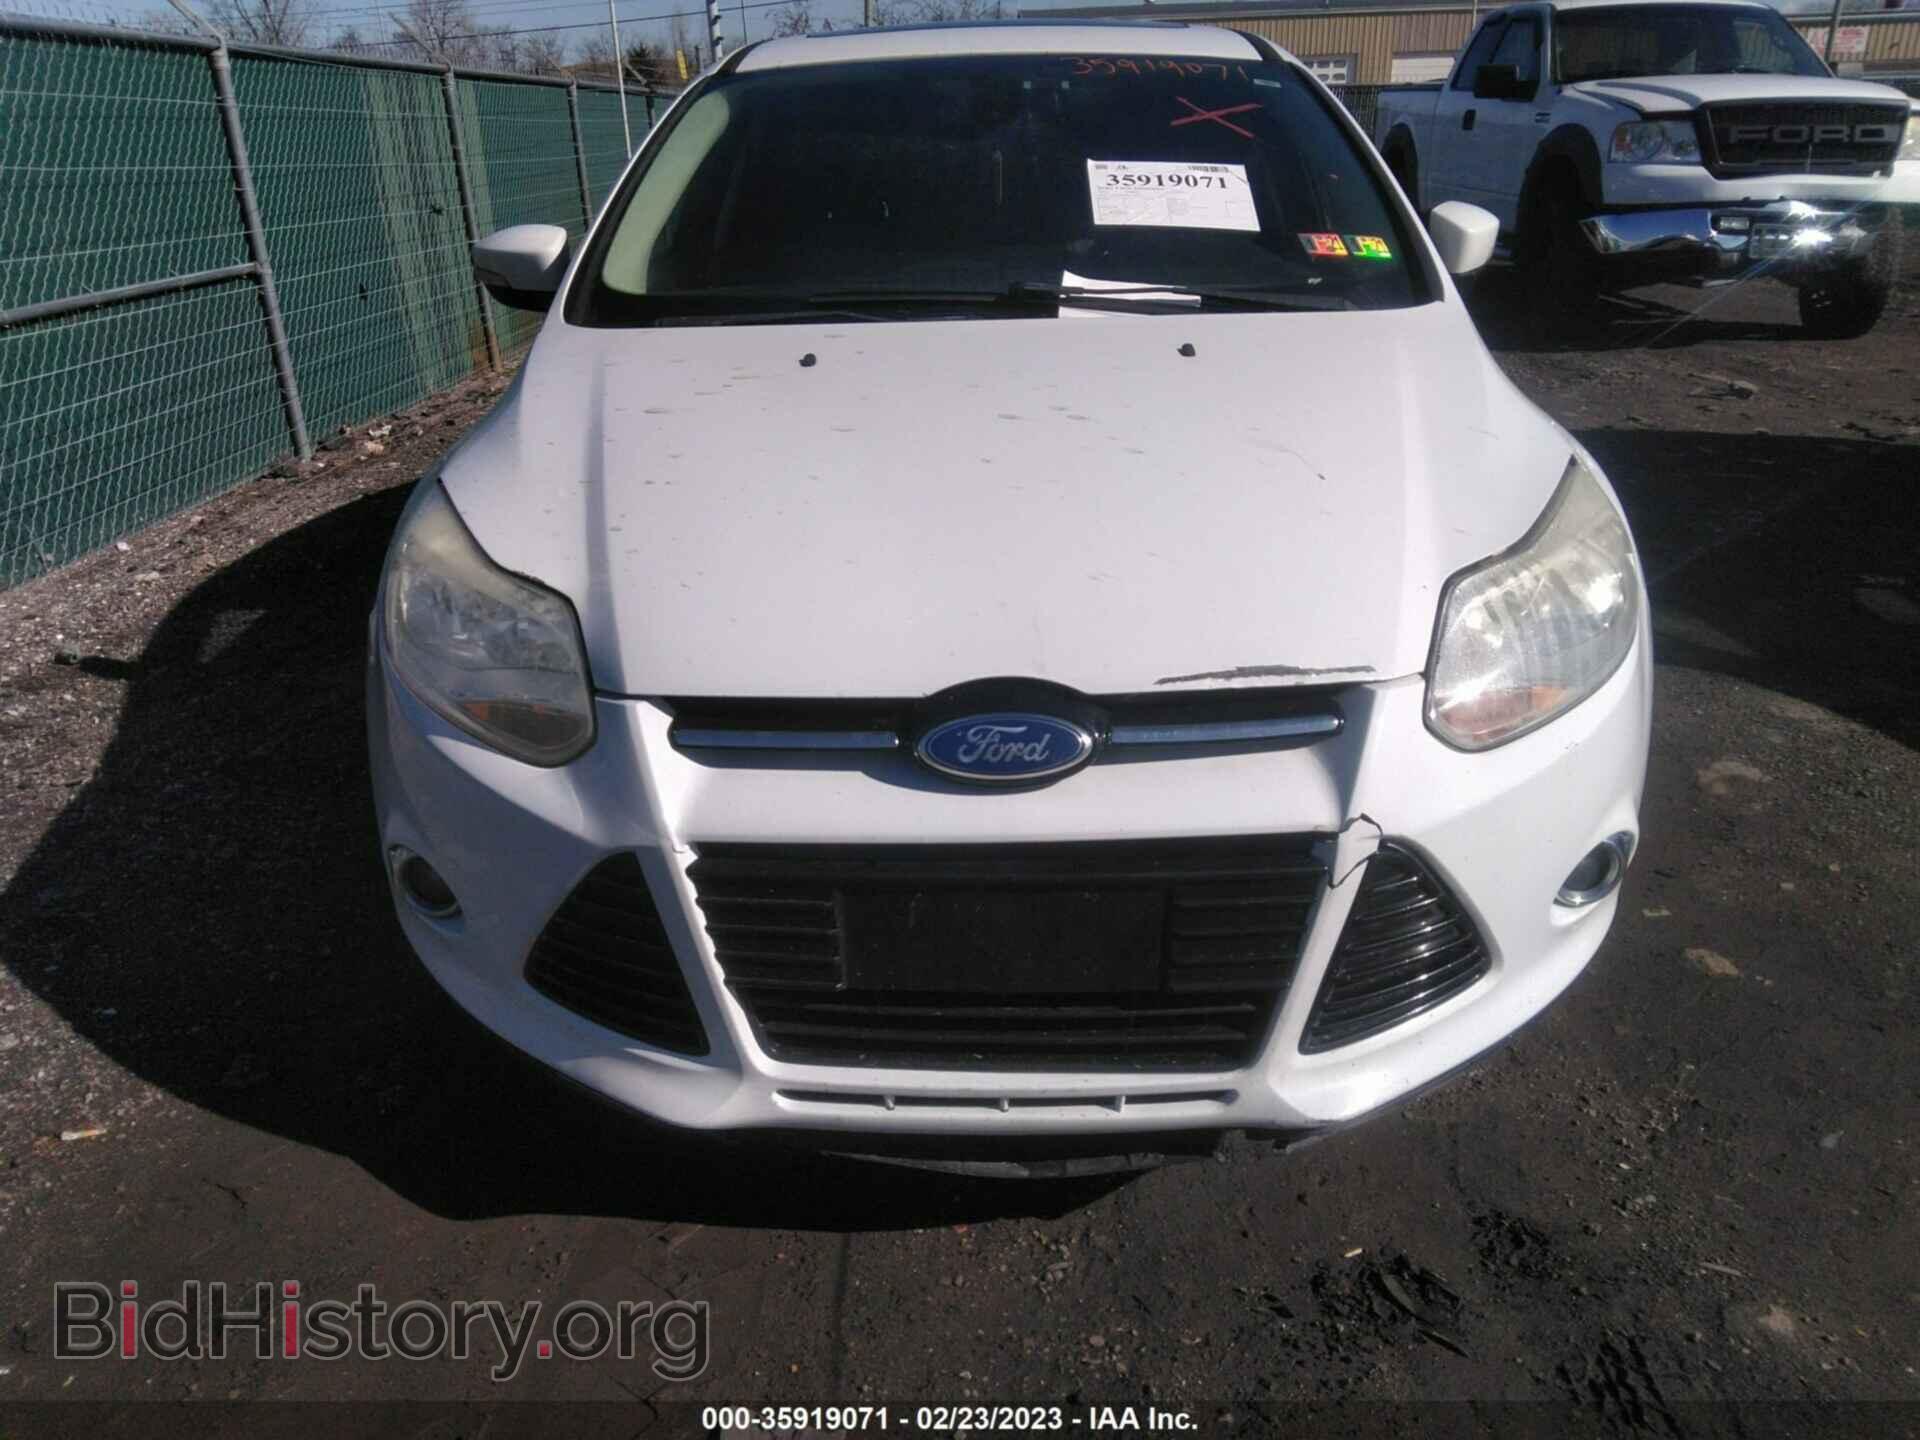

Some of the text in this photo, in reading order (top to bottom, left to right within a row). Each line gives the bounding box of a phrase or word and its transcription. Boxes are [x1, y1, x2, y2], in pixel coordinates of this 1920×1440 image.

[1730, 124, 1900, 143] FORD
[1106, 174, 1228, 189] 35919071
[958, 725, 1052, 763] Ford
